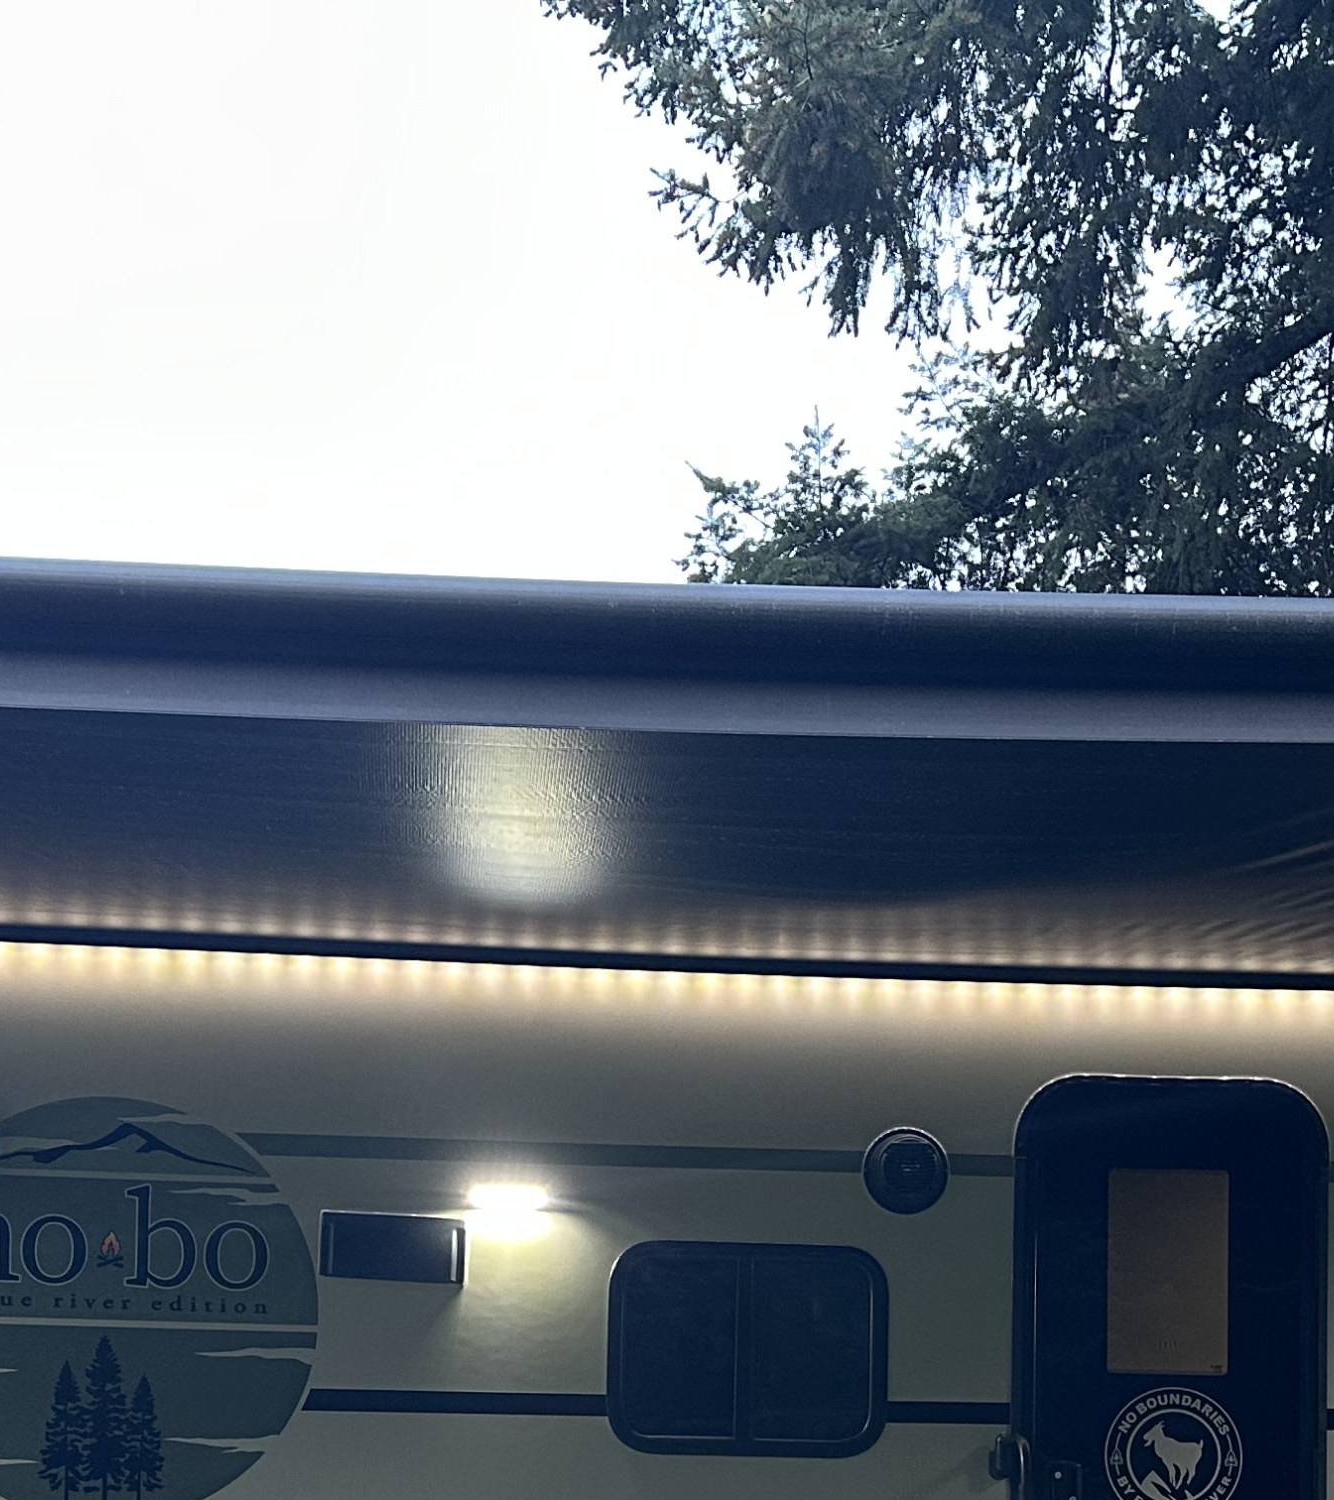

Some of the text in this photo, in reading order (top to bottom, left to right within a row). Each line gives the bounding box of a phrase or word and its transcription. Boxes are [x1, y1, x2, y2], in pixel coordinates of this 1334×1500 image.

[53, 1293, 131, 1310] river
[151, 1296, 269, 1315] edition
[1118, 1393, 1230, 1436] NO BOUNDARIES
[1117, 1475, 1136, 1495] BY
